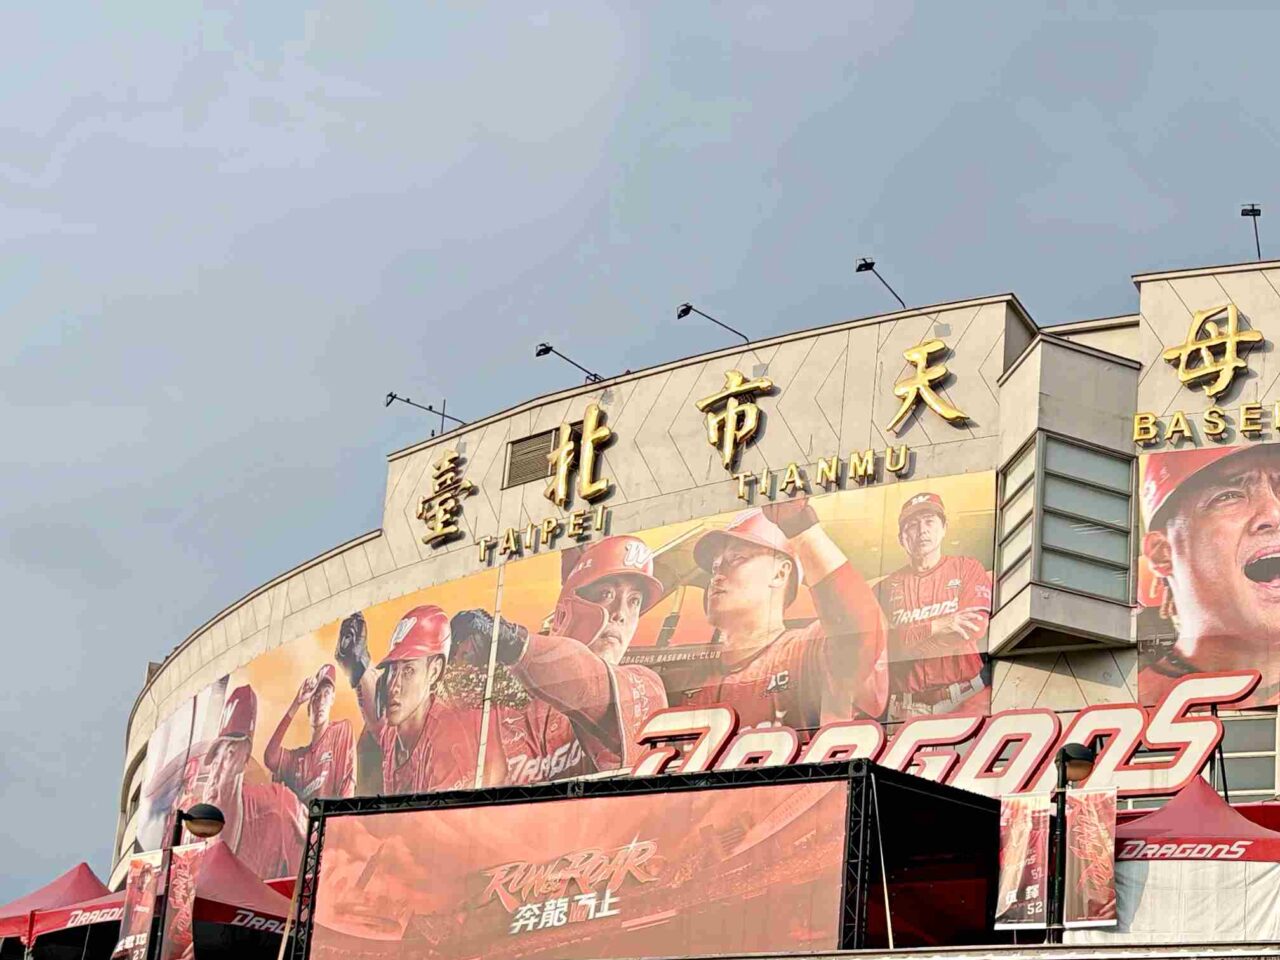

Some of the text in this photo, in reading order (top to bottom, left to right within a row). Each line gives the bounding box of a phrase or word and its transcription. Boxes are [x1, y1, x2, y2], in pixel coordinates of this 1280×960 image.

[735, 443, 909, 499] TIANMU
[477, 507, 613, 562] TAIPEI
[656, 652, 696, 663] BASEBALL
[700, 651, 721, 660] CLUB
[1117, 840, 1253, 859] DRAGONS
[1027, 902, 1043, 915] 52
[132, 948, 146, 960] 27
